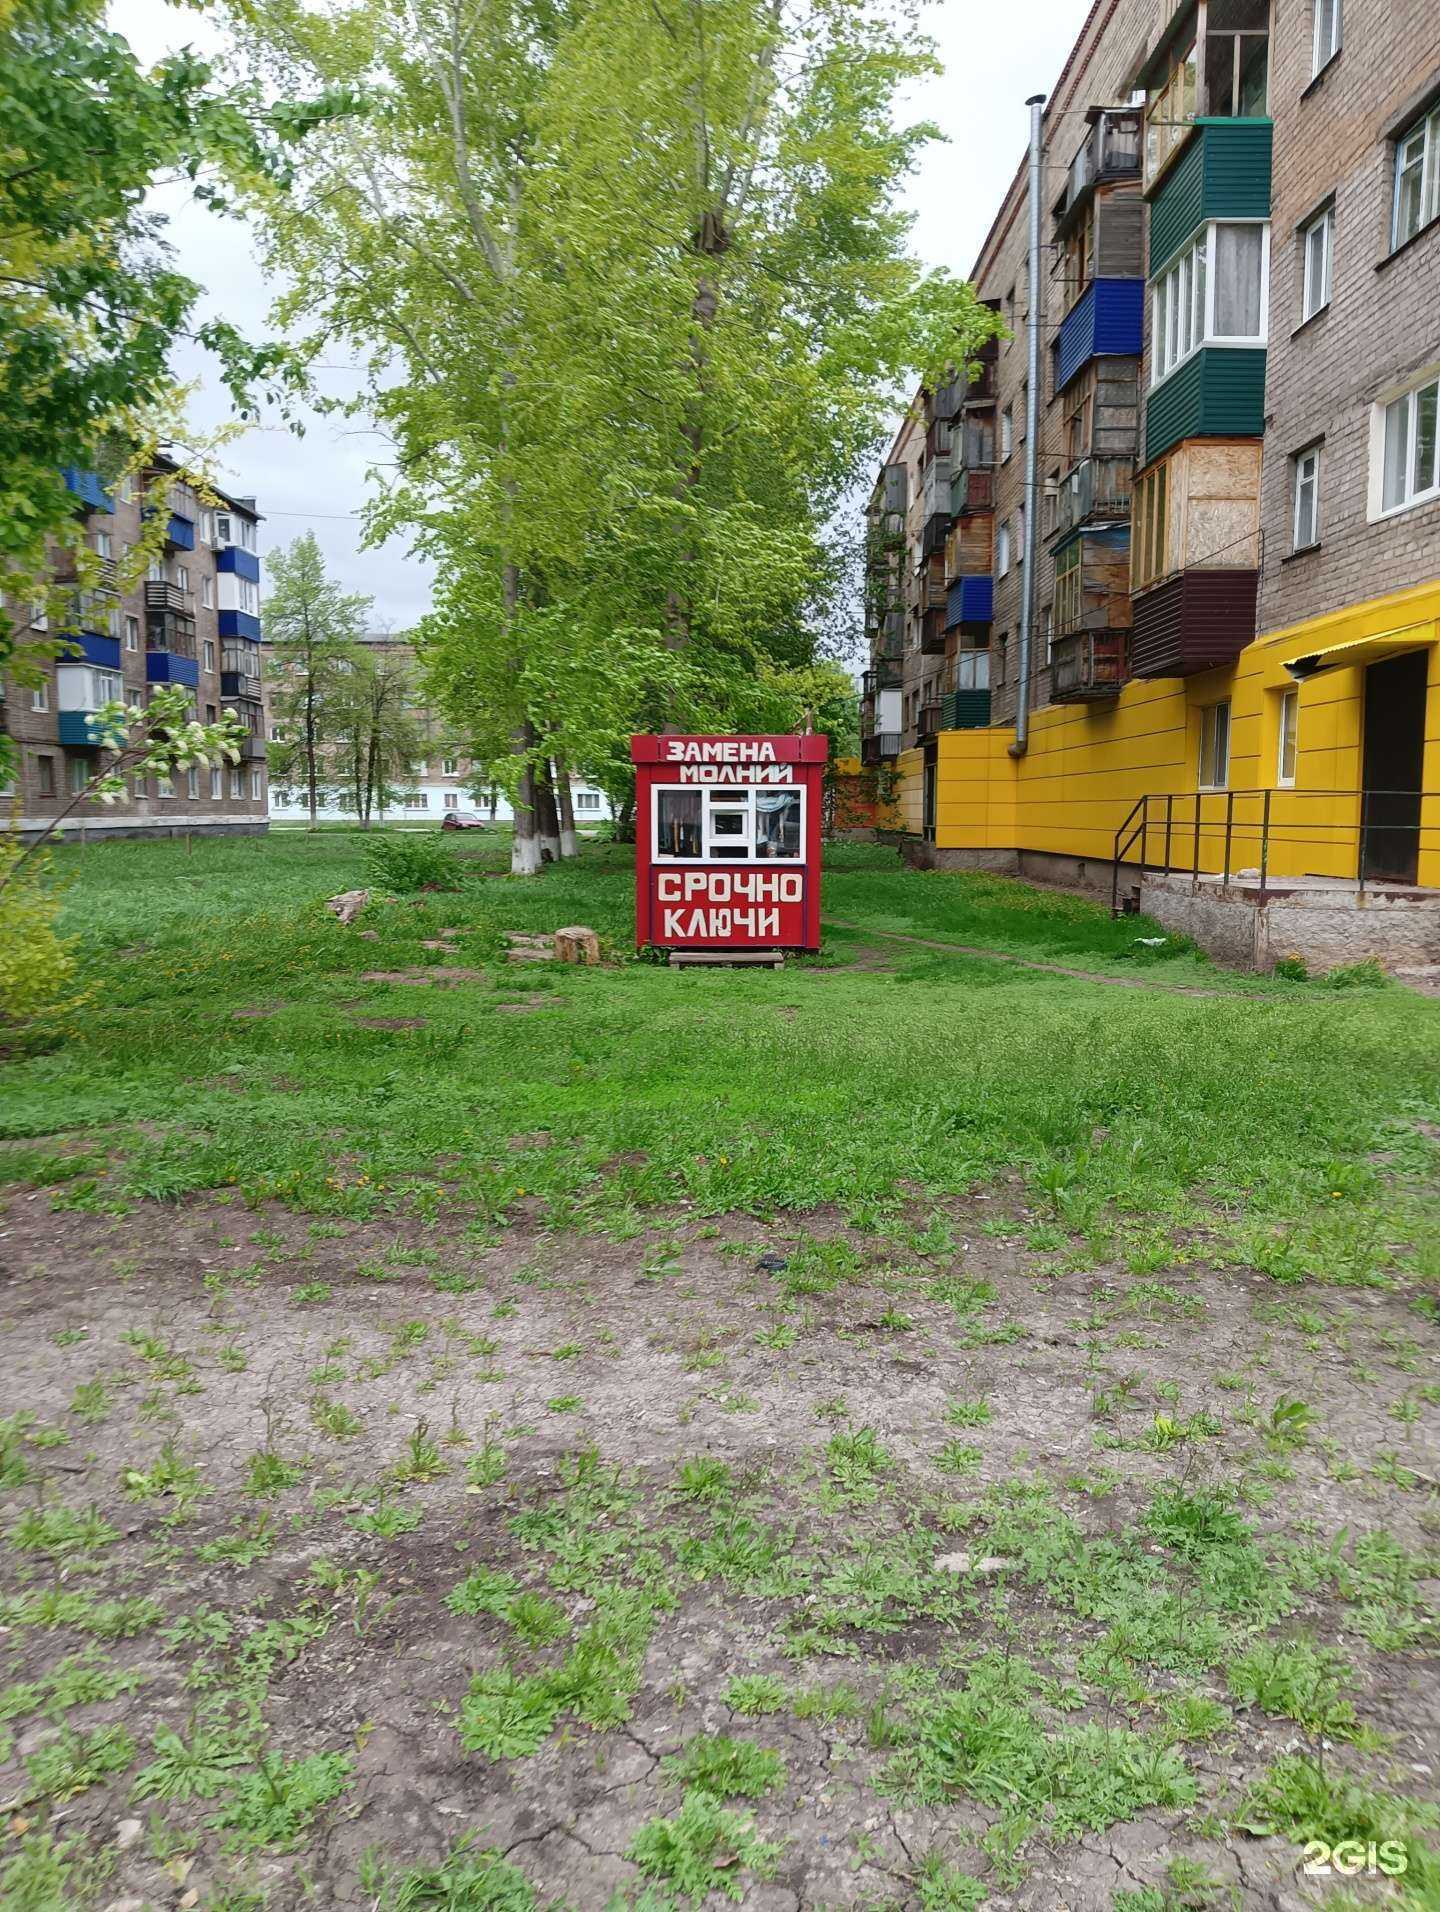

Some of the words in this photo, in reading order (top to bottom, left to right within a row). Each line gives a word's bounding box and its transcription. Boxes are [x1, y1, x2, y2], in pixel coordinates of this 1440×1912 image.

[666, 741, 775, 762] ЗАМЕНА
[680, 763, 792, 783] МОЛНИЙ
[658, 872, 803, 902] СРОЧНО
[664, 908, 780, 937] КЛЮЧИ
